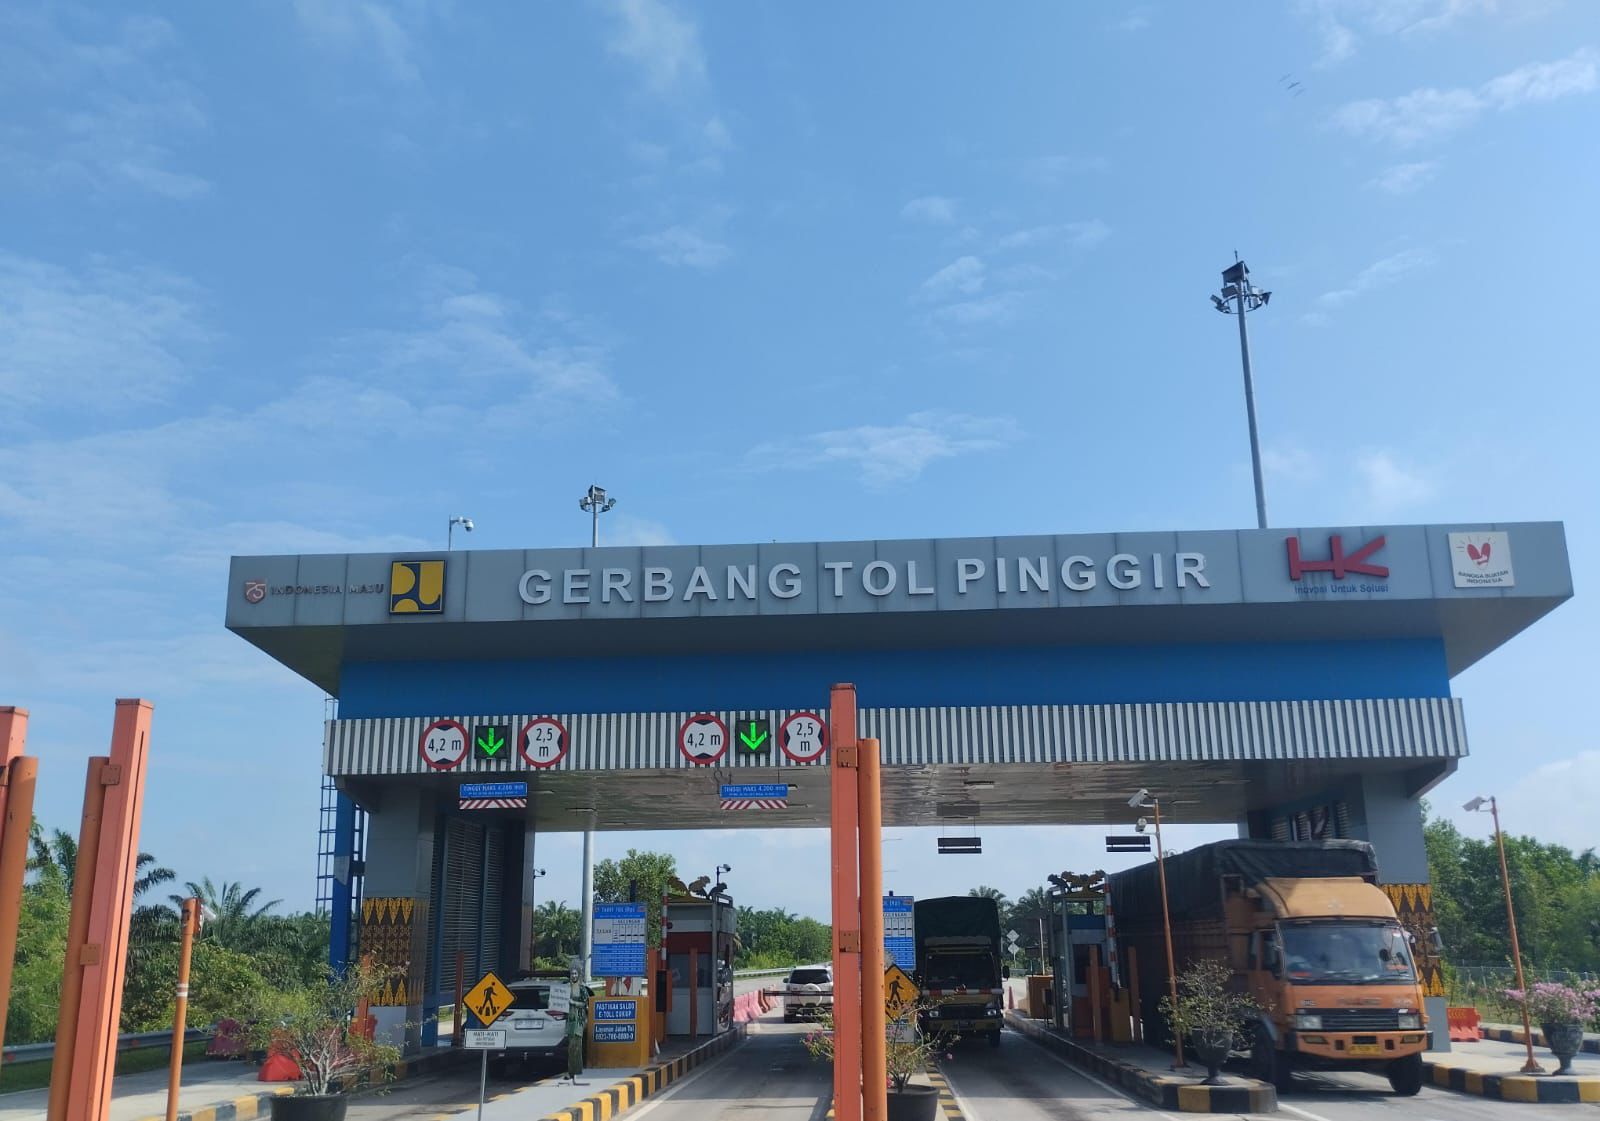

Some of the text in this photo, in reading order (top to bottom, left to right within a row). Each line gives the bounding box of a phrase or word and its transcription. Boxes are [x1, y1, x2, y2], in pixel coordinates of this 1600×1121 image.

[518, 552, 1210, 605] GERBANG TOL PINGGIR
[271, 585, 343, 596] INDONESIA
[1330, 584, 1358, 593] Untuk
[1359, 583, 1389, 593] Solusi
[536, 727, 553, 743] 2,5
[796, 722, 814, 738] 2,5
[428, 738, 462, 754] 4,2 m
[687, 732, 721, 748] 4,2 m
[800, 740, 811, 752] m
[538, 745, 549, 757] m
